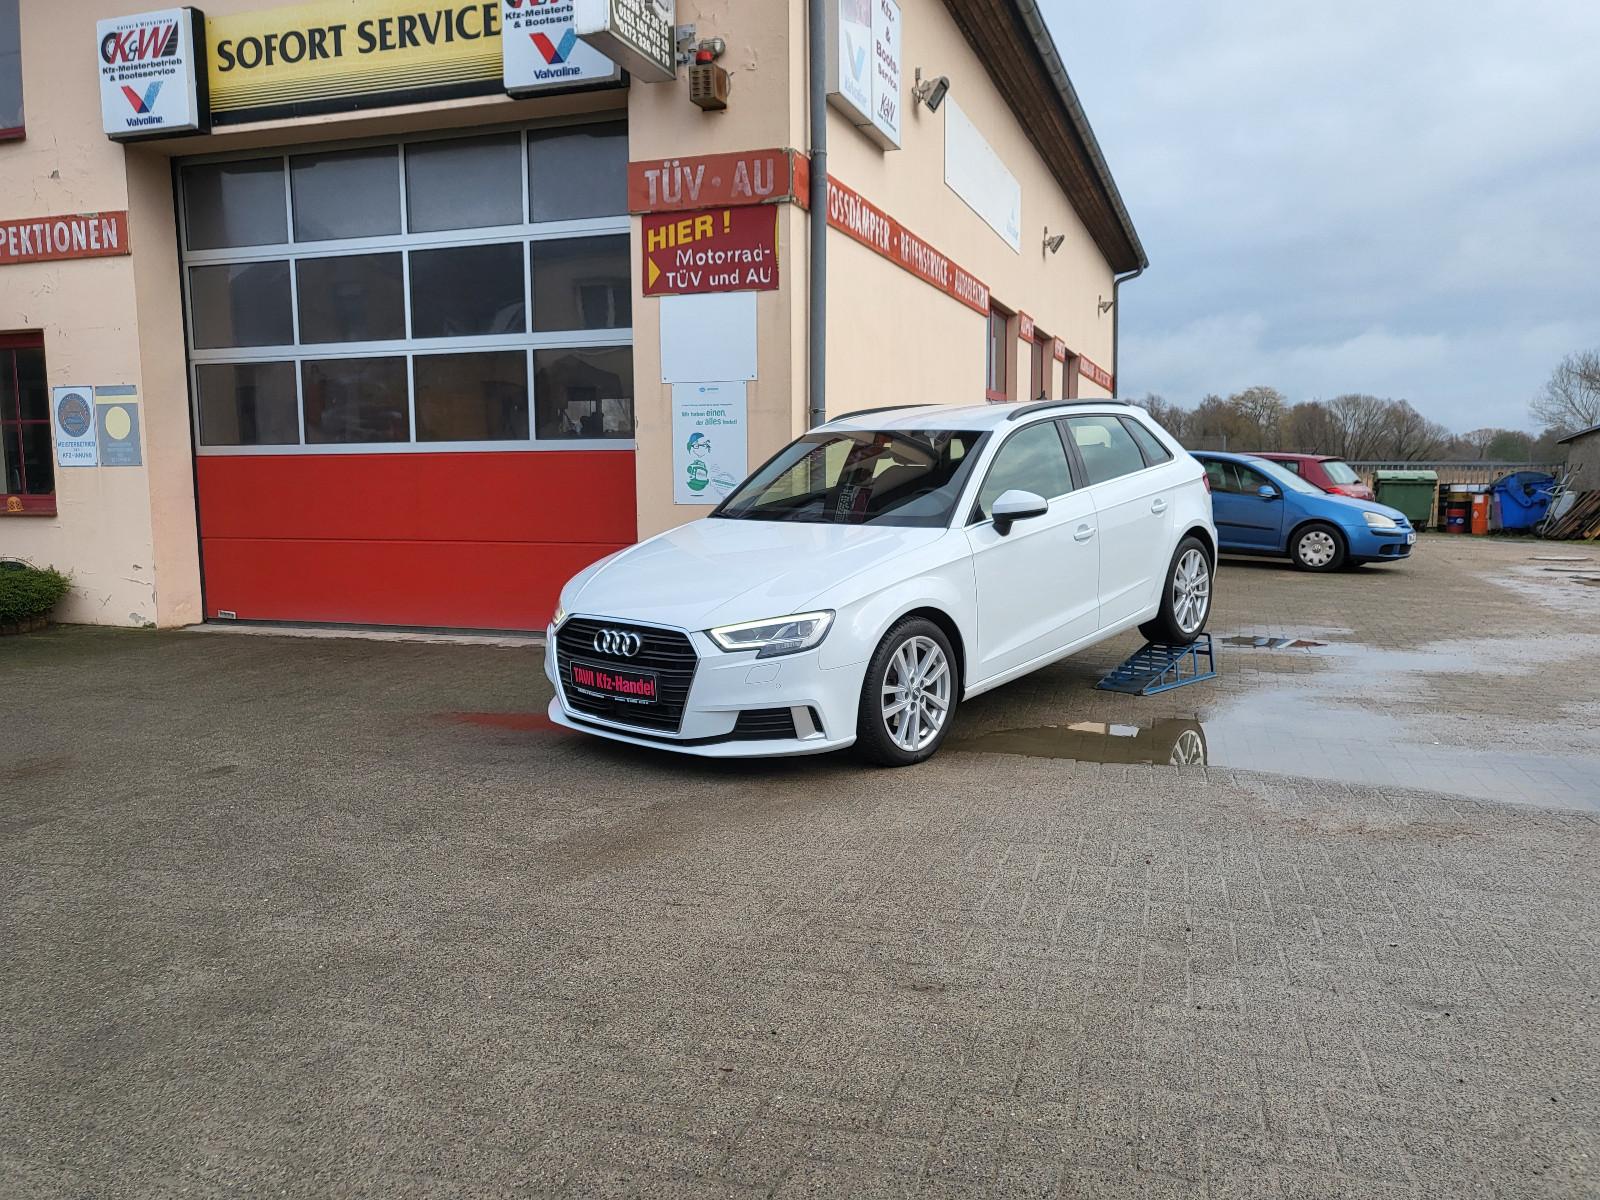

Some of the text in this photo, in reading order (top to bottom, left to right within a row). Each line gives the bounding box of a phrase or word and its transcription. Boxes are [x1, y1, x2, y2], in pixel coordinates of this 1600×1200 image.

[216, 3, 501, 72] SOFORT SERVICE
[102, 58, 182, 74] Kfz-Meisterbetrieb
[118, 68, 176, 80] Bootsservice
[533, 66, 580, 80] Valvoline
[126, 115, 163, 127] Valvoline
[644, 159, 774, 204] TÜV AU
[648, 214, 714, 252] HIER
[676, 243, 770, 266] Motorrad-
[666, 266, 772, 288] TÜV und AU
[596, 672, 655, 696] Kfz-Handel
